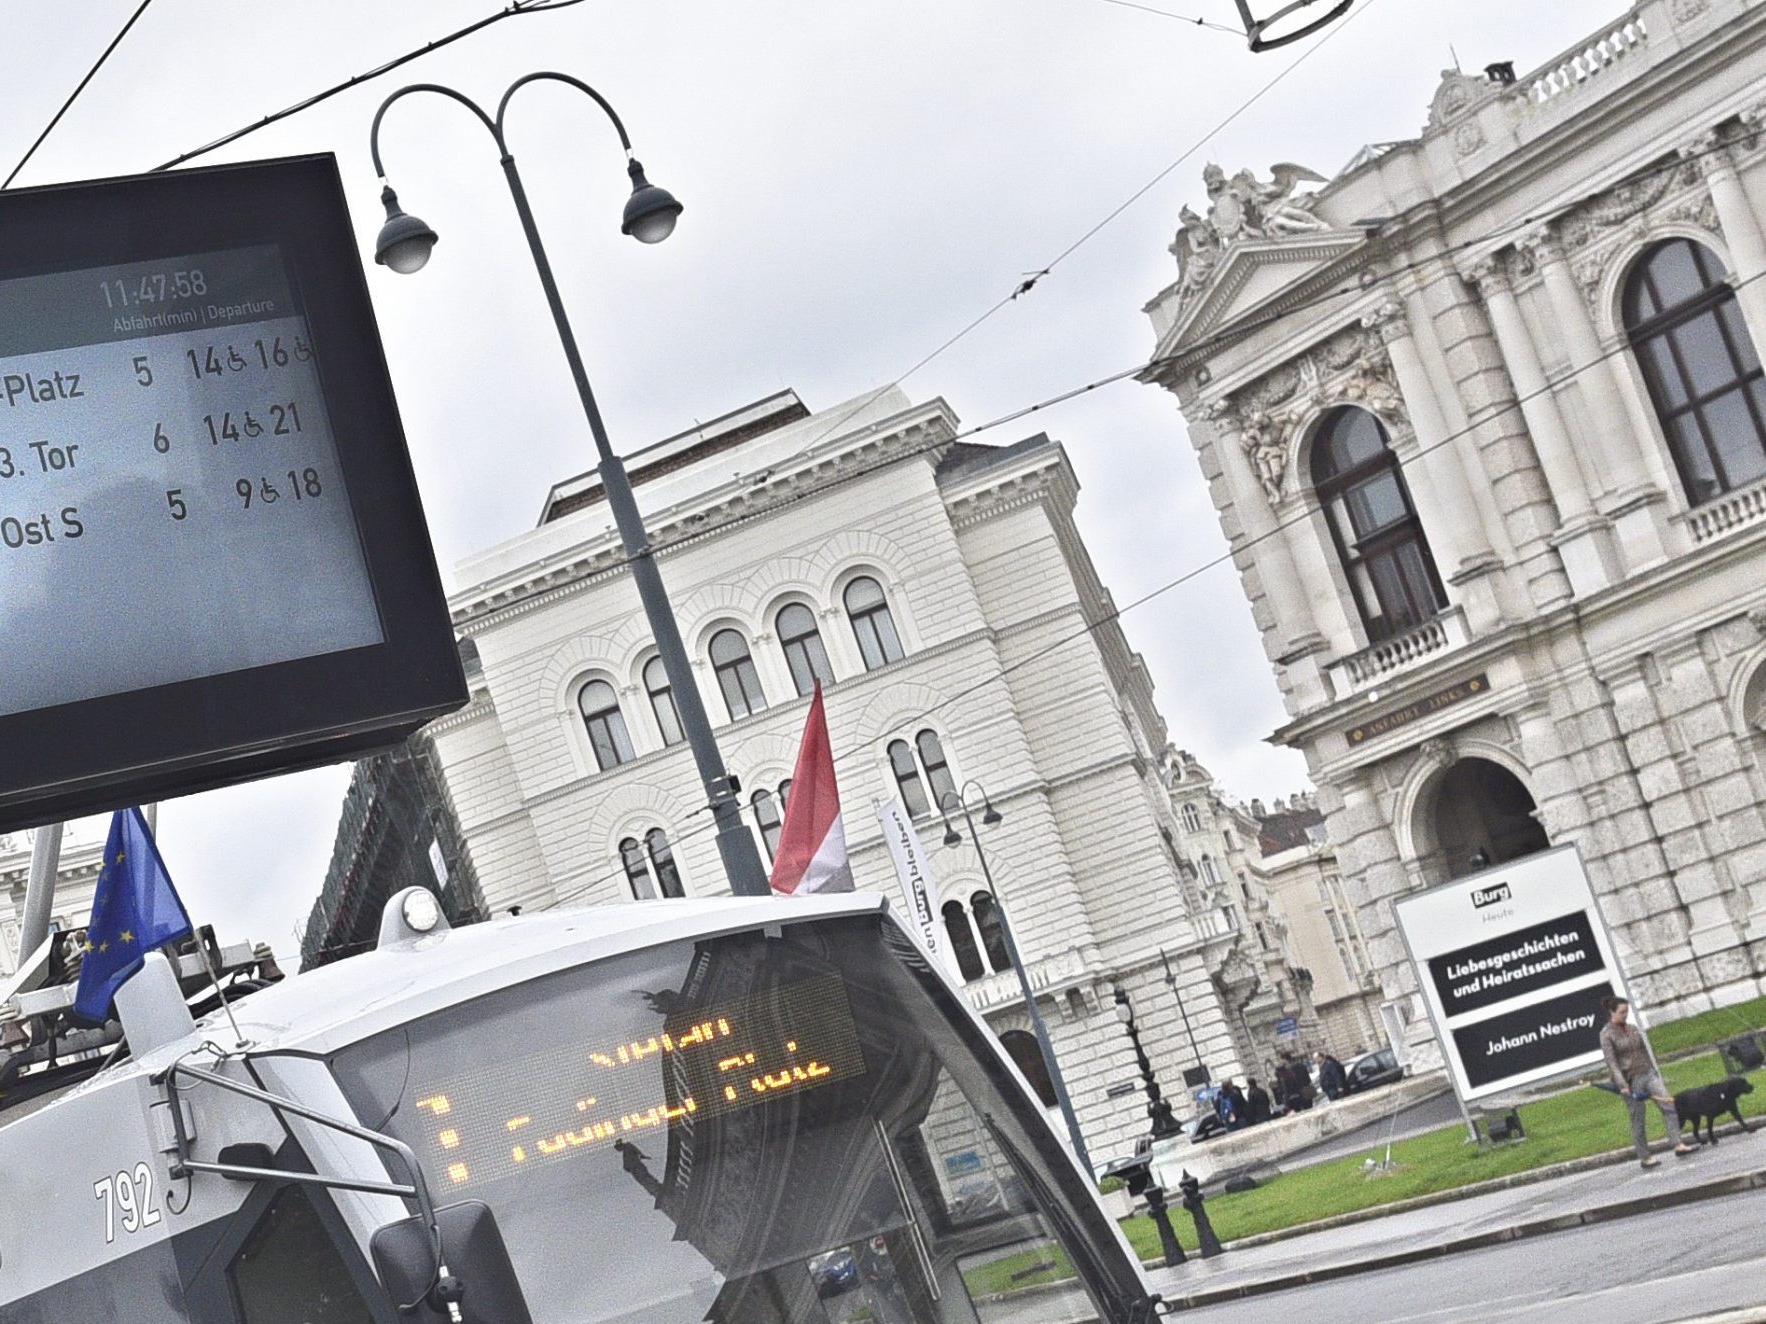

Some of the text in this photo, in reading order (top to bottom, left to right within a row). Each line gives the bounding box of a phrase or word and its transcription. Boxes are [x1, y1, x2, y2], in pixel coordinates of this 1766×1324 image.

[100, 270, 207, 308] 11:47:58
[113, 299, 275, 333] Abfahrt(min) Departure
[132, 355, 154, 387] 5
[186, 346, 223, 379] 14
[254, 337, 289, 370] 16
[29, 439, 80, 475] Tor
[152, 422, 171, 454] 6
[203, 412, 240, 445] 14
[269, 402, 302, 436] 21
[0, 511, 56, 549] Ost
[60, 506, 85, 539] S
[166, 488, 187, 520] 5
[235, 478, 253, 509] 9
[287, 467, 323, 500] 18
[891, 810, 920, 878] bleiben
[1471, 884, 1511, 908] Burg
[1482, 909, 1514, 924] Heute
[1446, 930, 1580, 981] Liebesgeschichten
[1453, 949, 1587, 999] und Heiratssachen
[1485, 1012, 1597, 1057] Johann Nestroy
[94, 1161, 162, 1244] 792
